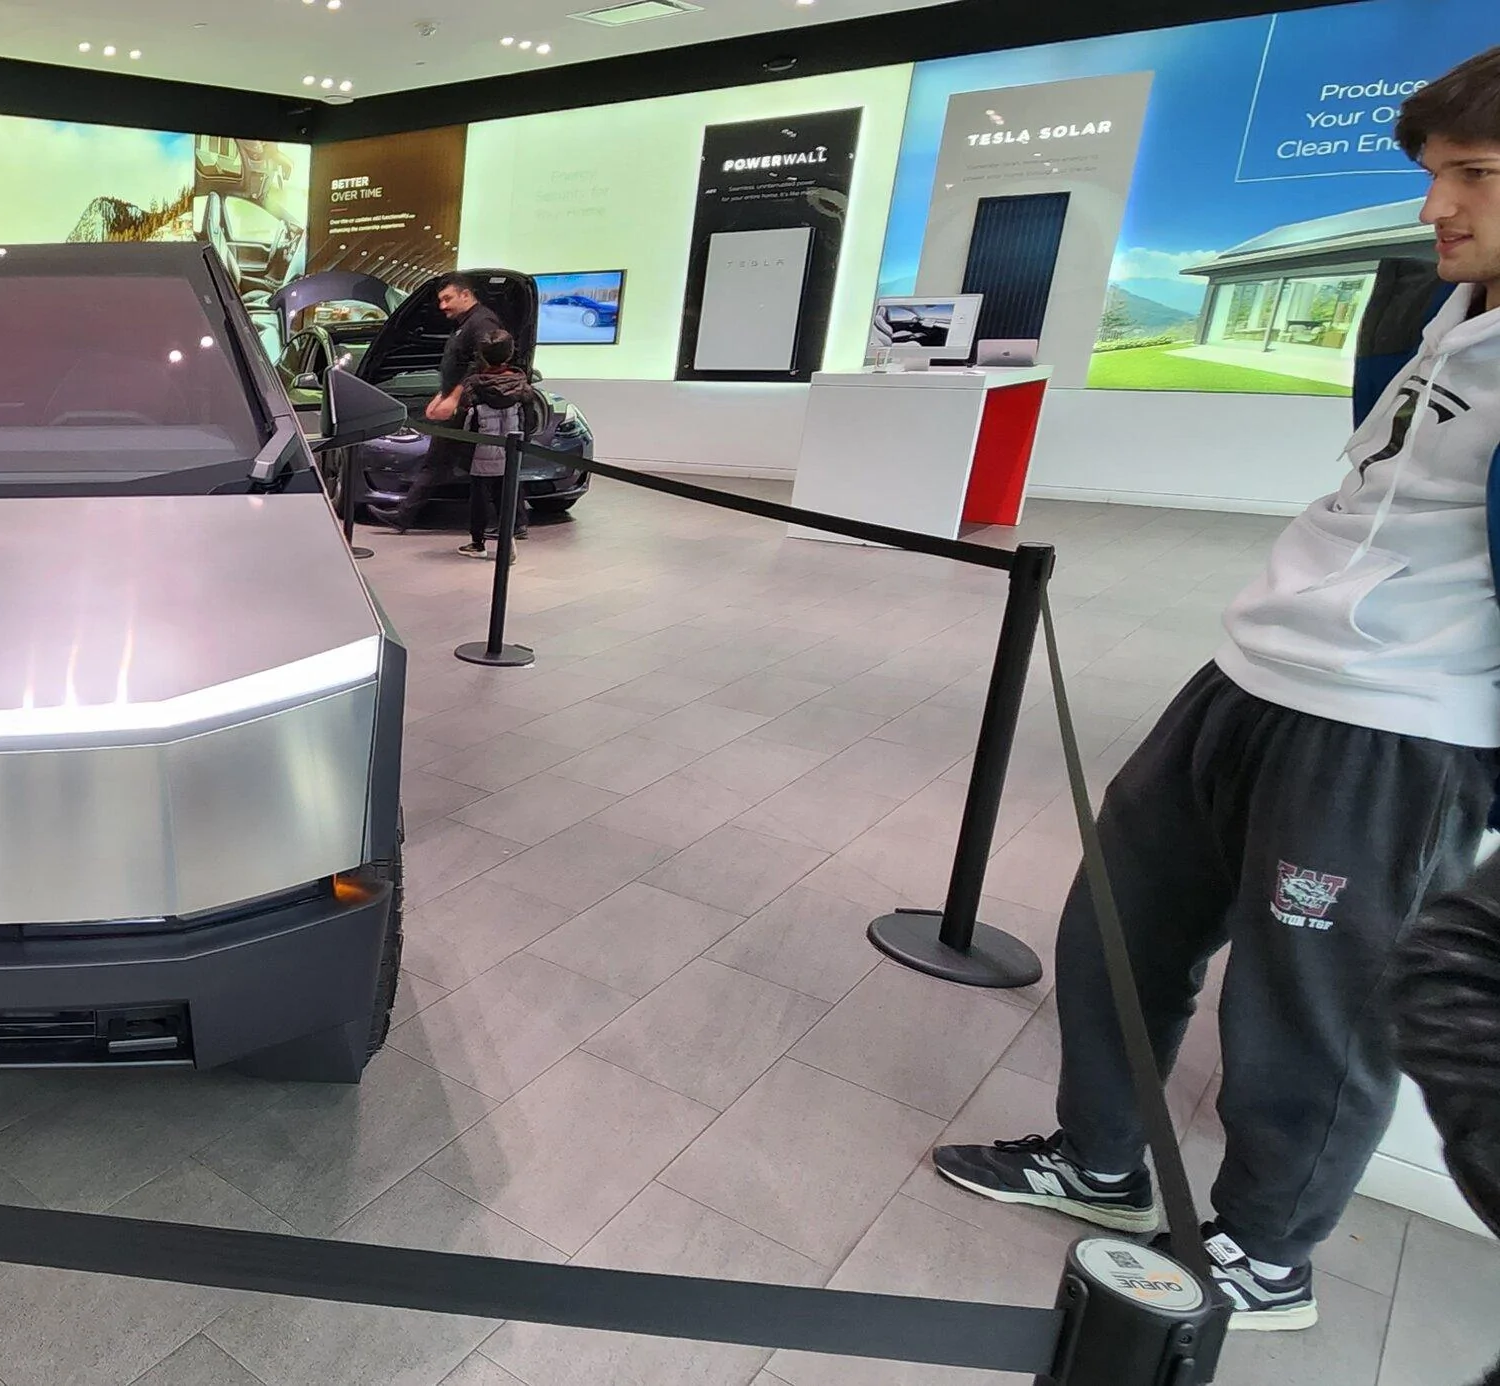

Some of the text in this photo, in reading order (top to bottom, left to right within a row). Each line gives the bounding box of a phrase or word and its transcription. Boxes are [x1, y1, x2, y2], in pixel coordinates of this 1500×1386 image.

[1320, 79, 1429, 101] Produce
[1306, 110, 1365, 128] Your
[967, 120, 1112, 146] TESLA SOLAR
[1277, 133, 1401, 159] Clean Ene
[723, 149, 828, 171] POWERWALL
[331, 176, 369, 190] BETTER
[331, 187, 383, 202] OVER TIME
[1116, 1278, 1184, 1293] QUEUE
